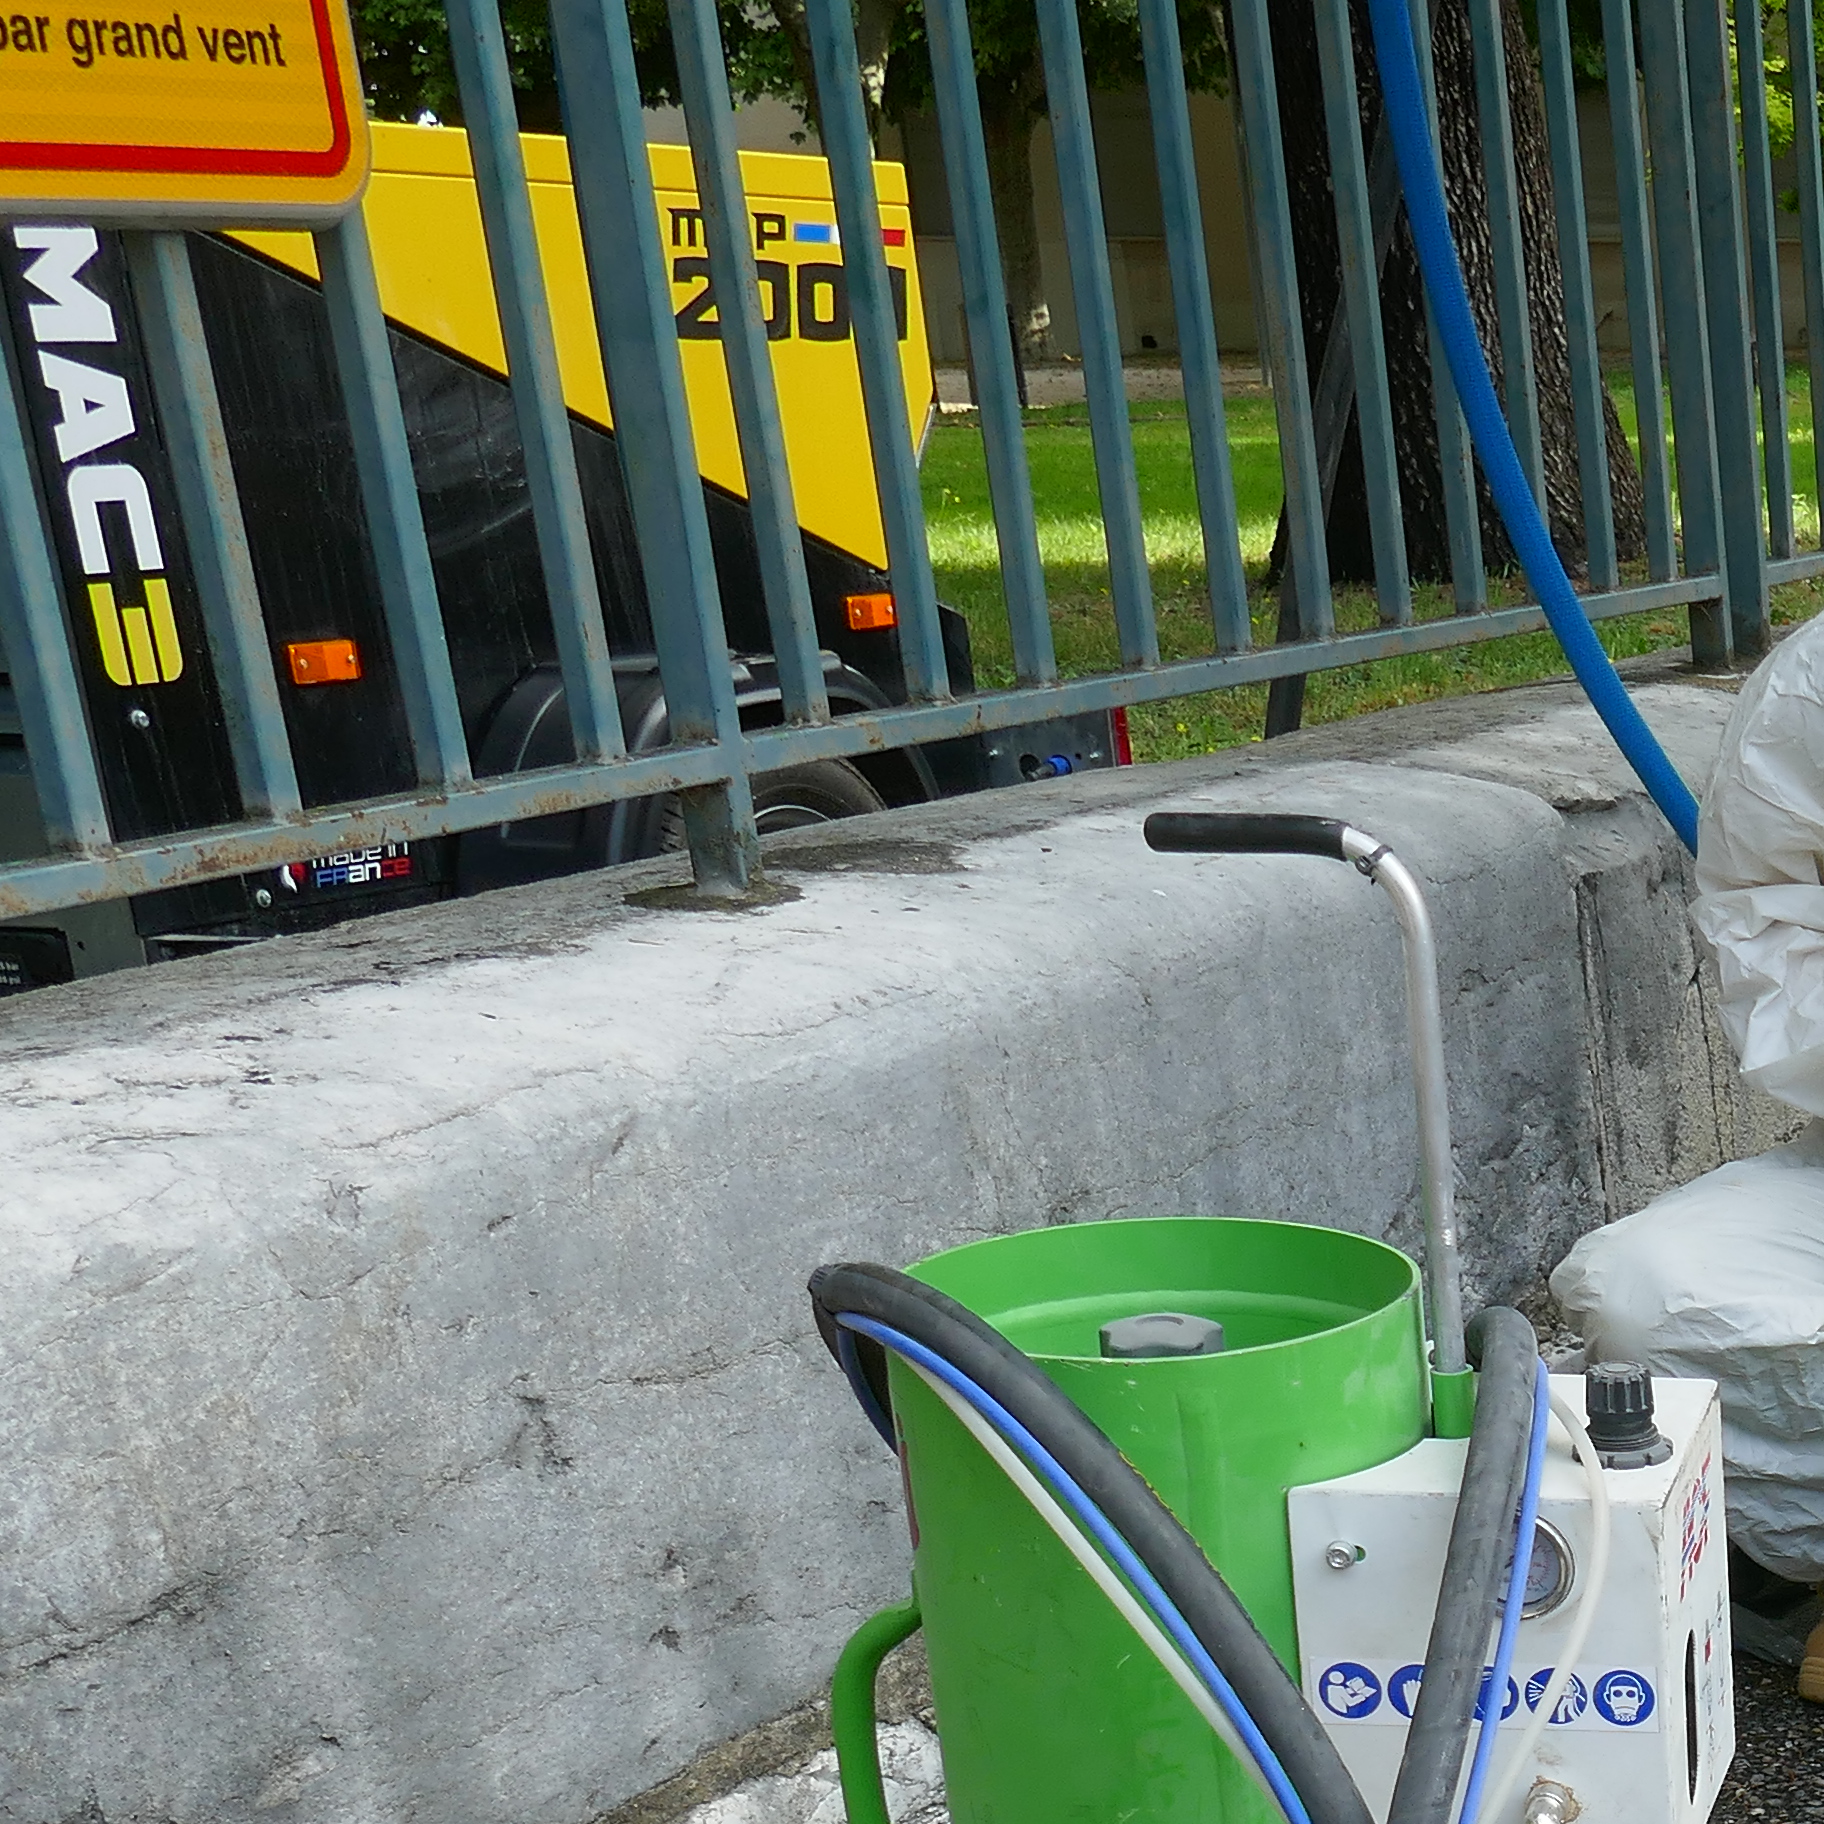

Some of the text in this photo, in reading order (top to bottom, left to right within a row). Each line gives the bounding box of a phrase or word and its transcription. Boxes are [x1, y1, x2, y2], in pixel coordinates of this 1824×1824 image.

[66, 13, 188, 68] grand
[197, 23, 287, 67] vent
[673, 256, 908, 343] 200
